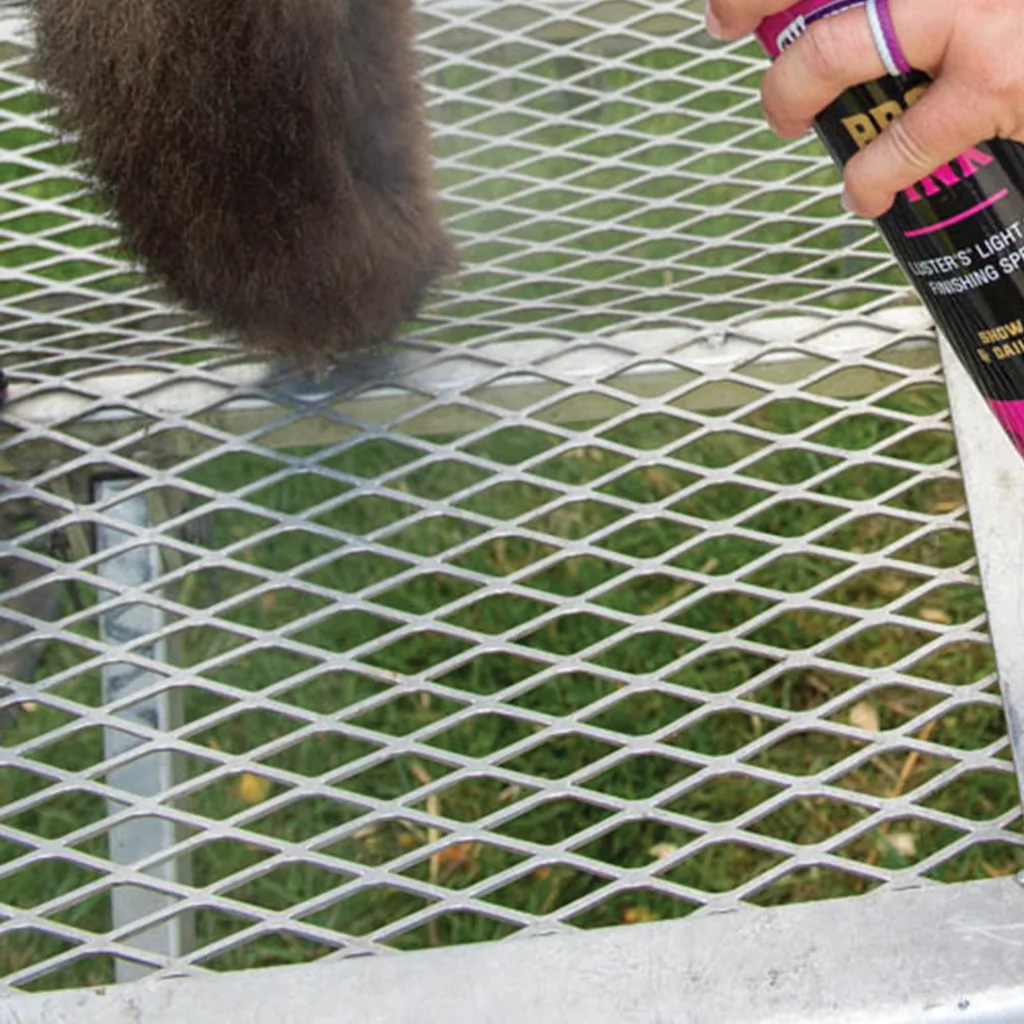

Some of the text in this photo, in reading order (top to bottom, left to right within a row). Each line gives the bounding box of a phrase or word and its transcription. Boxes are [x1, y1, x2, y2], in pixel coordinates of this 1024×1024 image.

[975, 222, 1024, 259] LIGHT
[929, 266, 1000, 296] FINISHING
[978, 319, 1024, 344] SHOW
